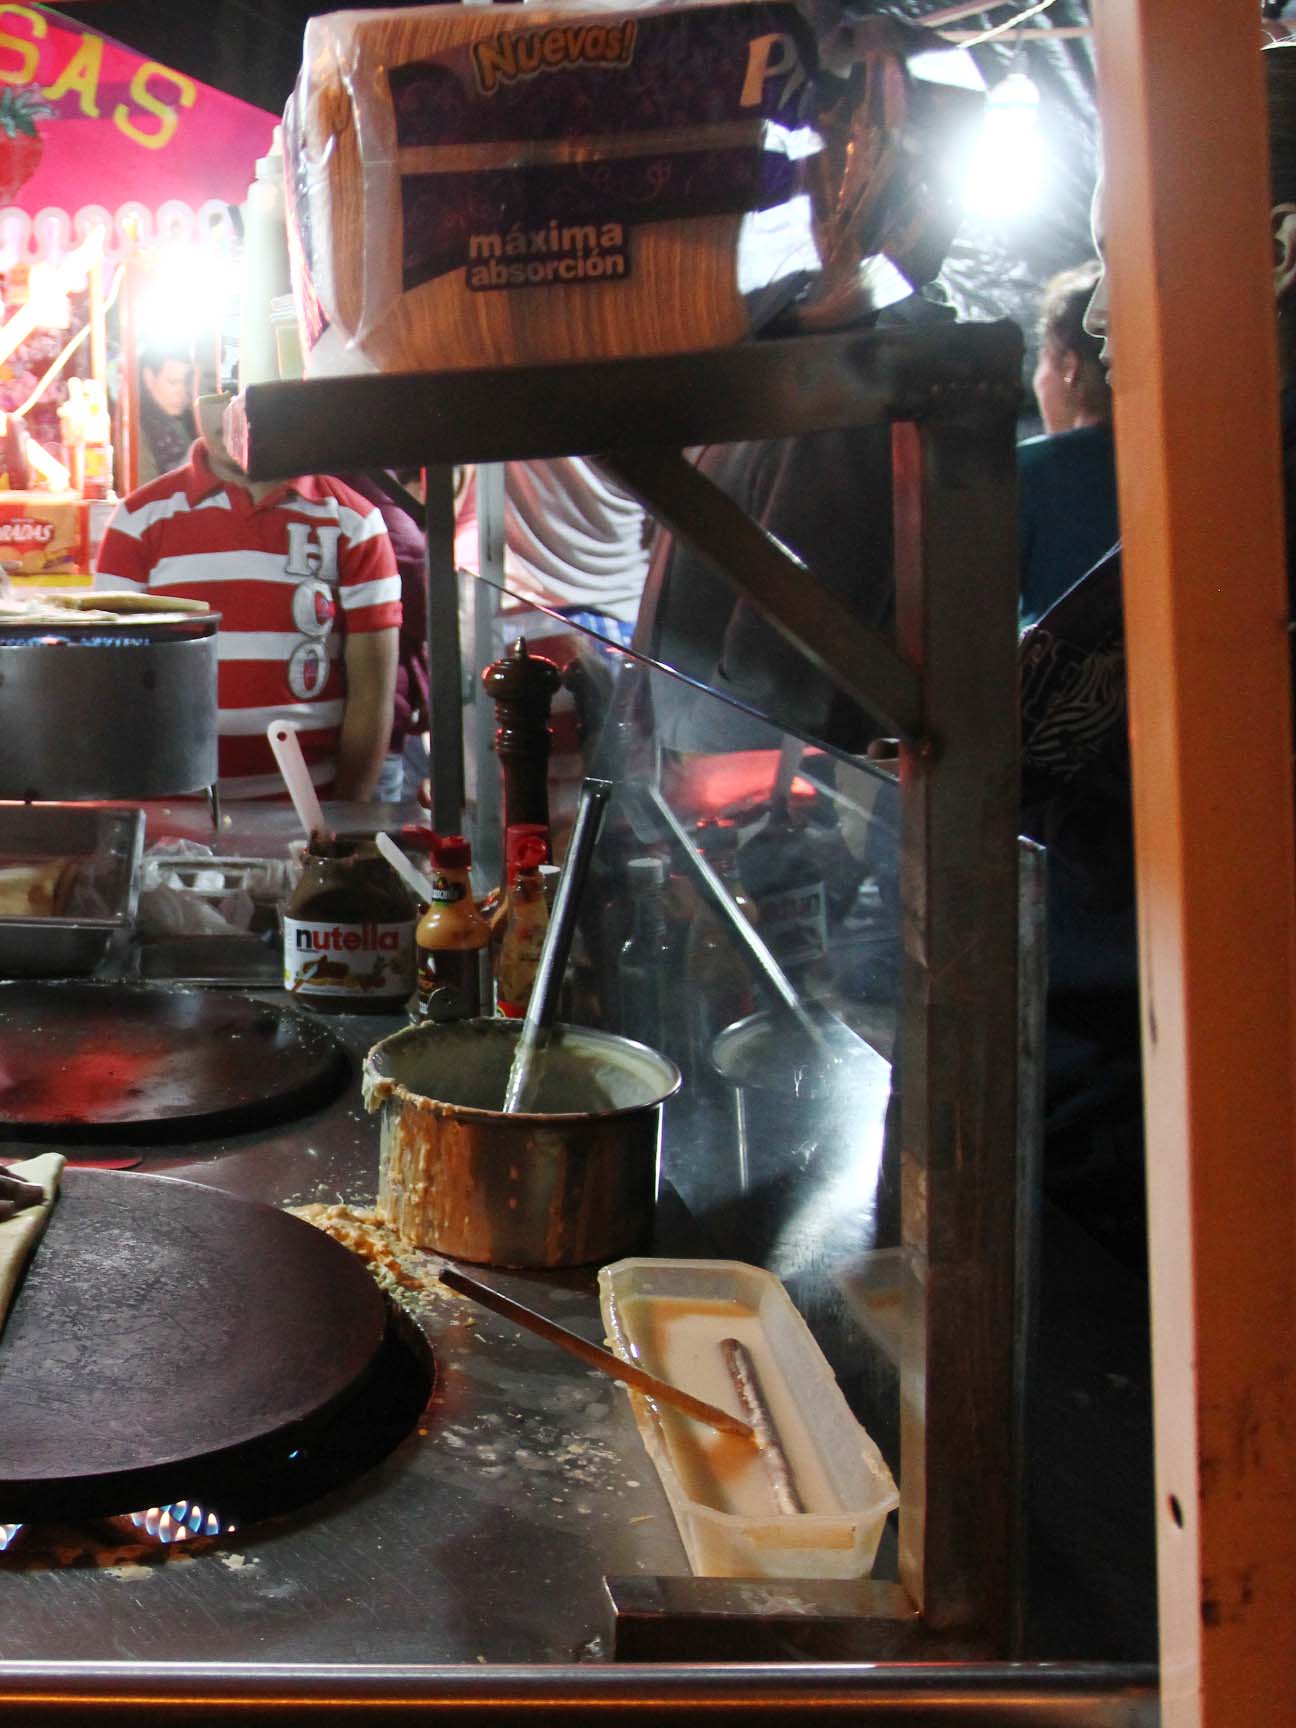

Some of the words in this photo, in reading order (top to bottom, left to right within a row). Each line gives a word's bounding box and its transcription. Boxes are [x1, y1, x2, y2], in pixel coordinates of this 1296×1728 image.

[474, 19, 636, 92] Nuevas!
[469, 219, 623, 257] máxima
[471, 248, 625, 287] absorción
[296, 922, 400, 951] nutella
